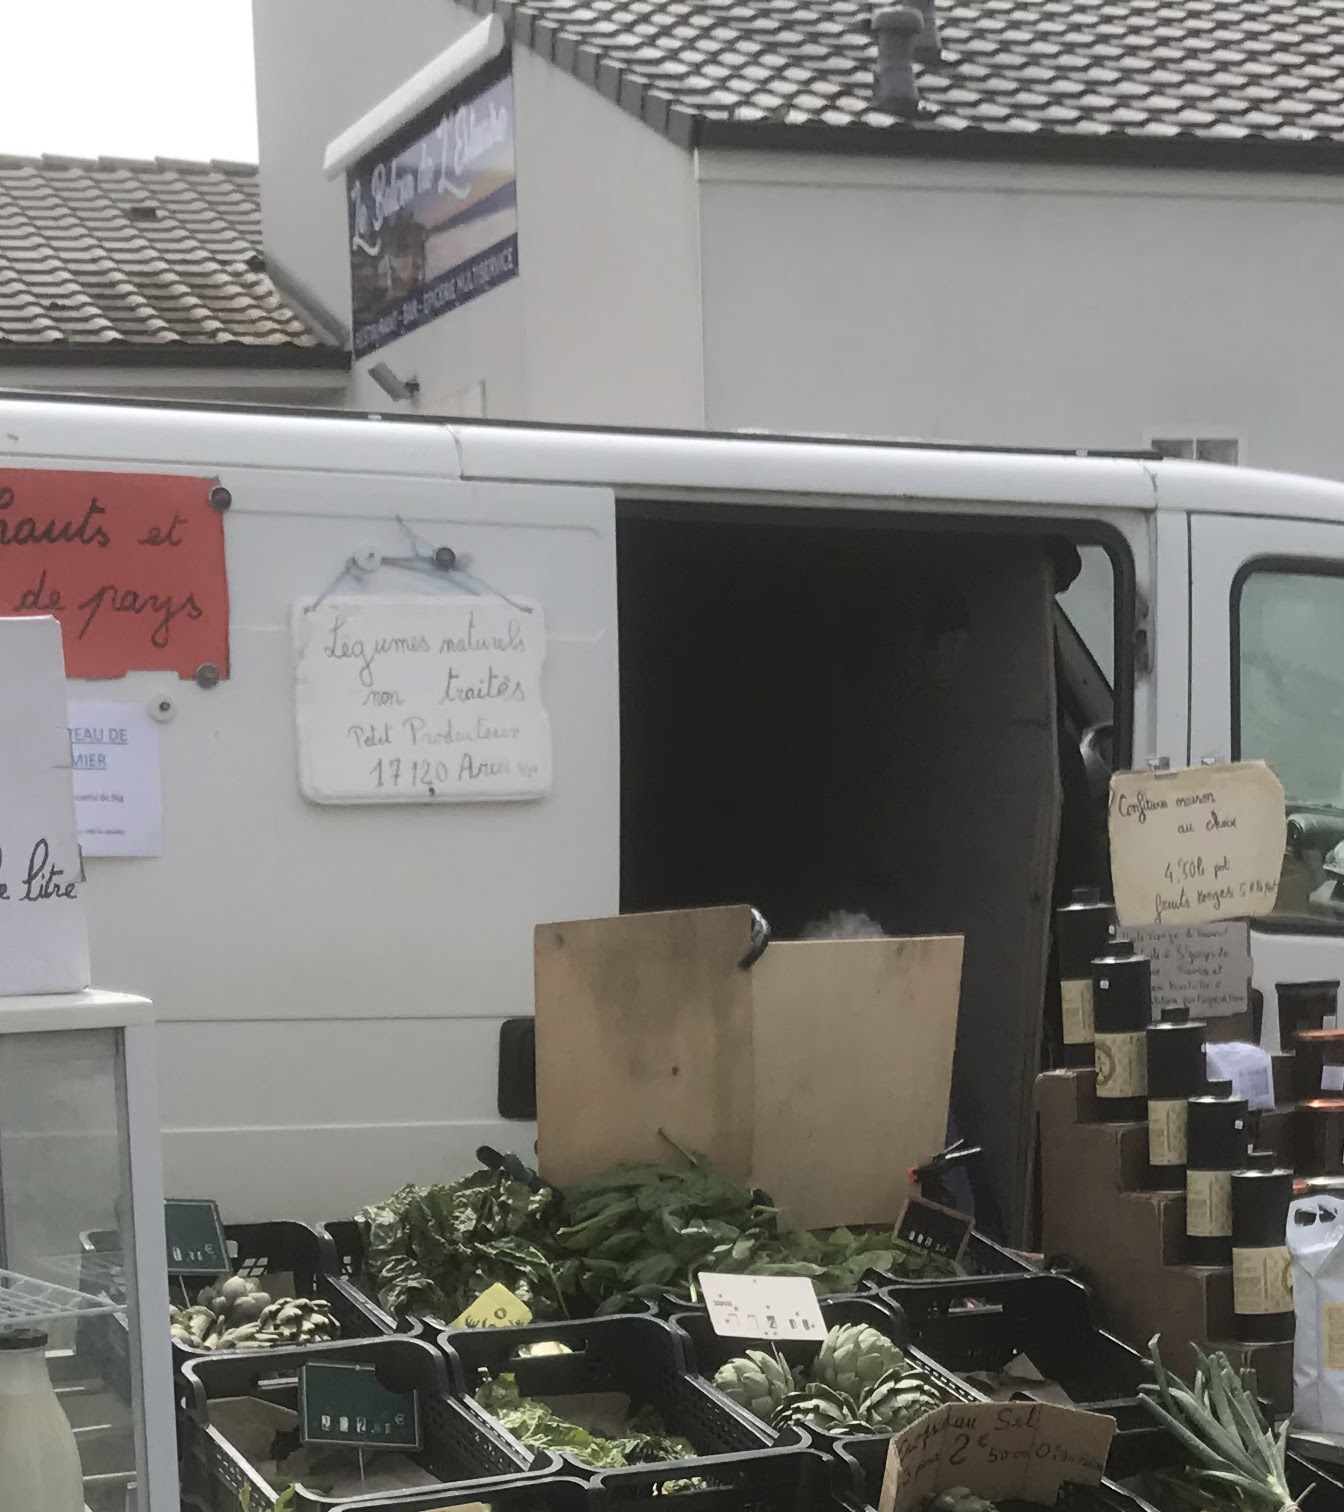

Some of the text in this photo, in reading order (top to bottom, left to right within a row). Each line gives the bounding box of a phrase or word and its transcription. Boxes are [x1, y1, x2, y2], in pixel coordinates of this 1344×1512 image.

[137, 513, 188, 548] et
[12, 568, 64, 613] de
[76, 590, 205, 648] pays
[439, 610, 525, 655] naturels
[362, 690, 405, 706] non
[71, 727, 103, 742] EAU
[73, 753, 106, 768] MIER
[1177, 823, 1194, 834] au
[19, 838, 77, 900] litre
